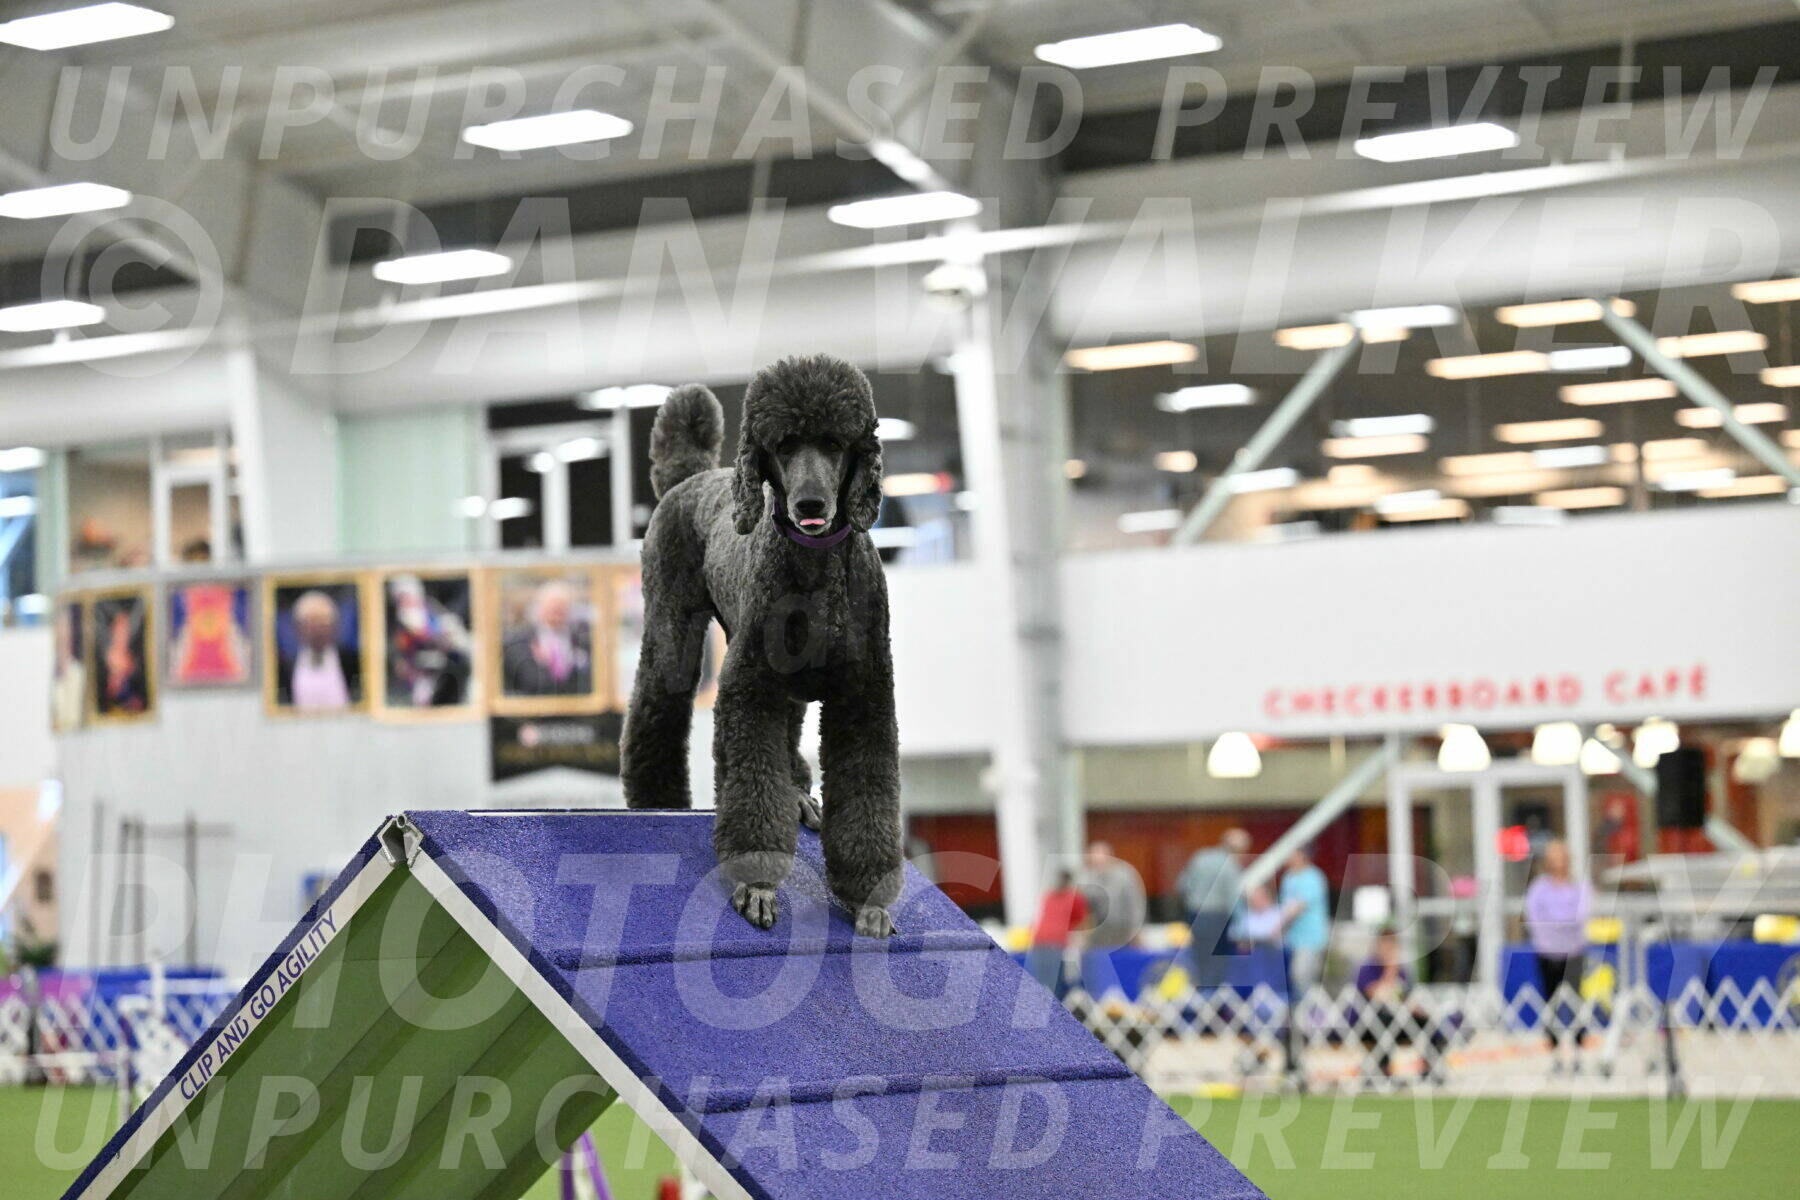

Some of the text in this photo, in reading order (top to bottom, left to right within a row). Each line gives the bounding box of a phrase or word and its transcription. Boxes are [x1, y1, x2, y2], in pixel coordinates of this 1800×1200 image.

[180, 909, 337, 1100] CLIP AND GO AGILITY
